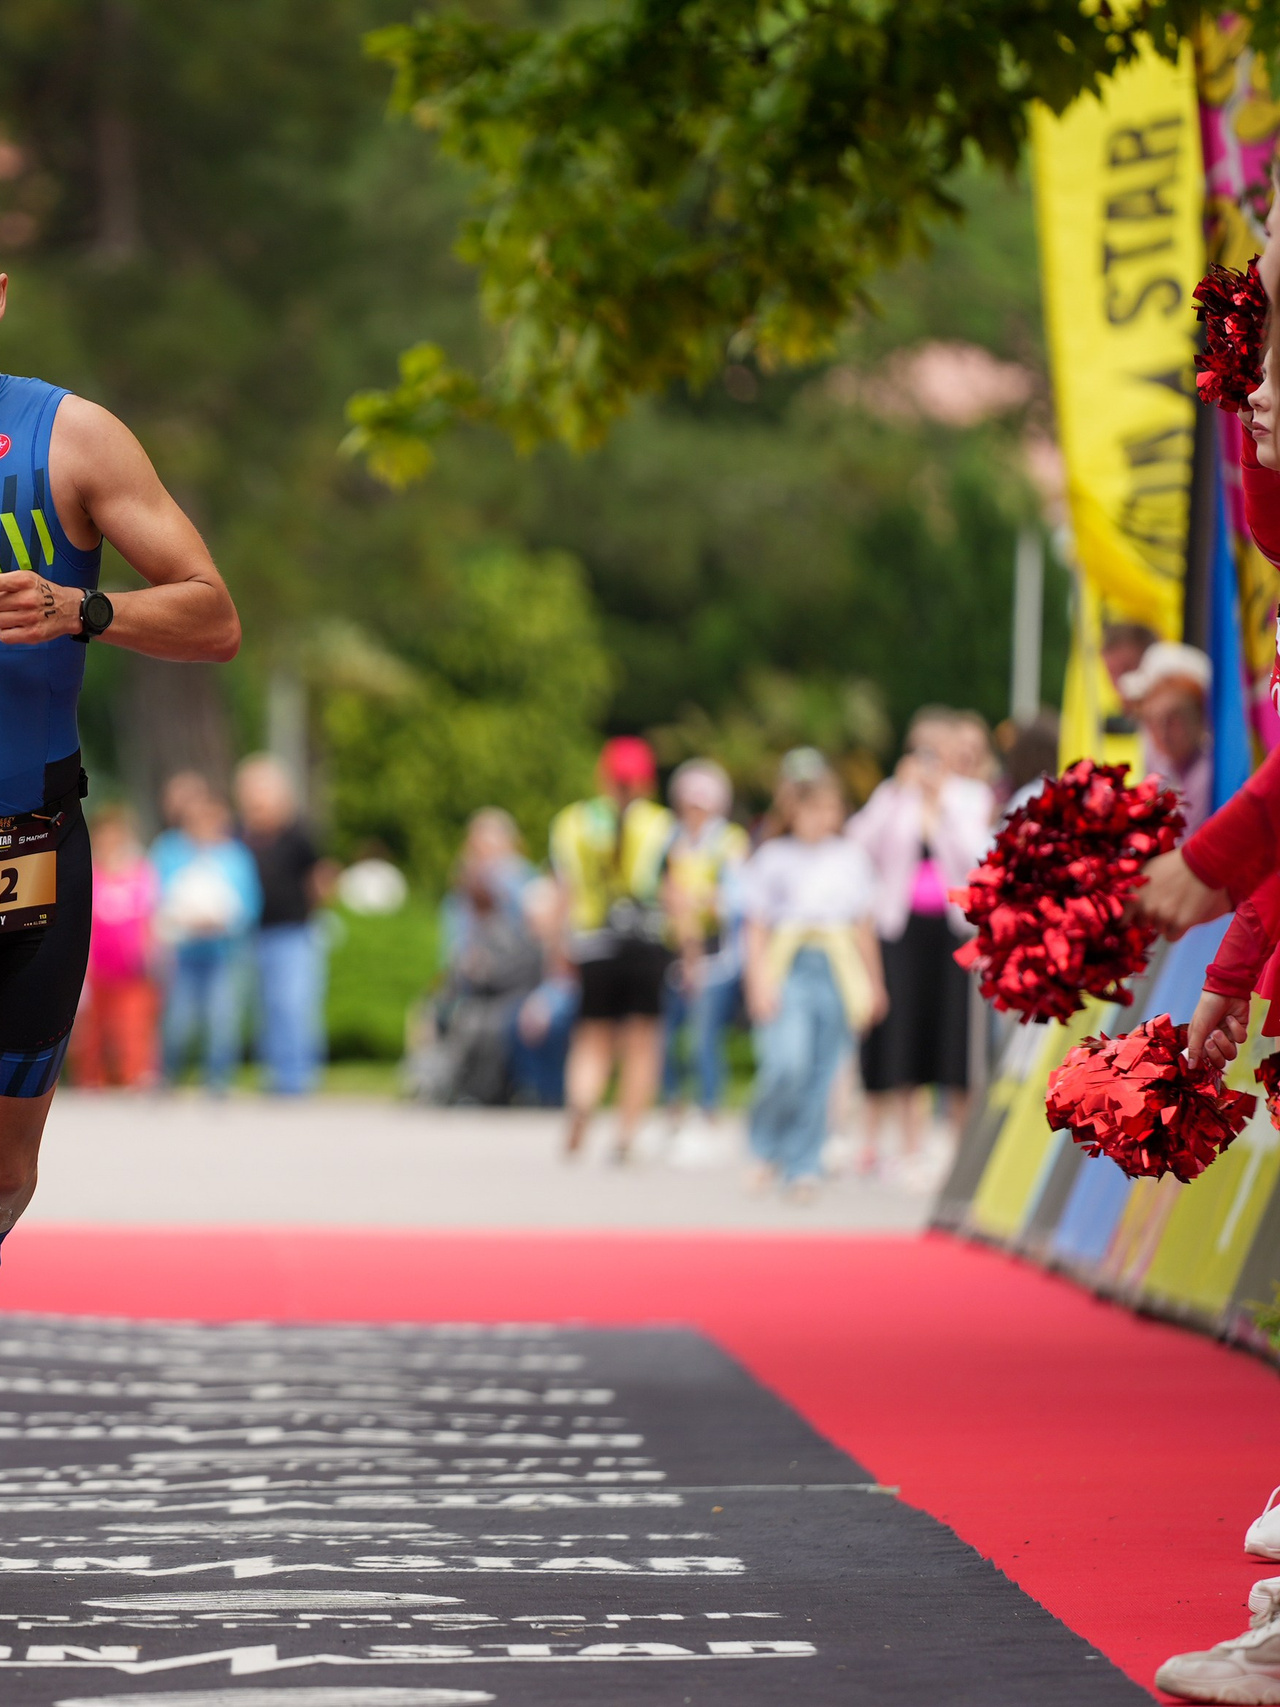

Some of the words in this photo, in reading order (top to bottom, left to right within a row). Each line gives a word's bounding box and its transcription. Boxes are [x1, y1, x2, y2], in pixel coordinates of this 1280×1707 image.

[1102, 114, 1183, 326] STAR
[354, 1555, 747, 1572] STAR
[368, 1640, 818, 1659] STAR
